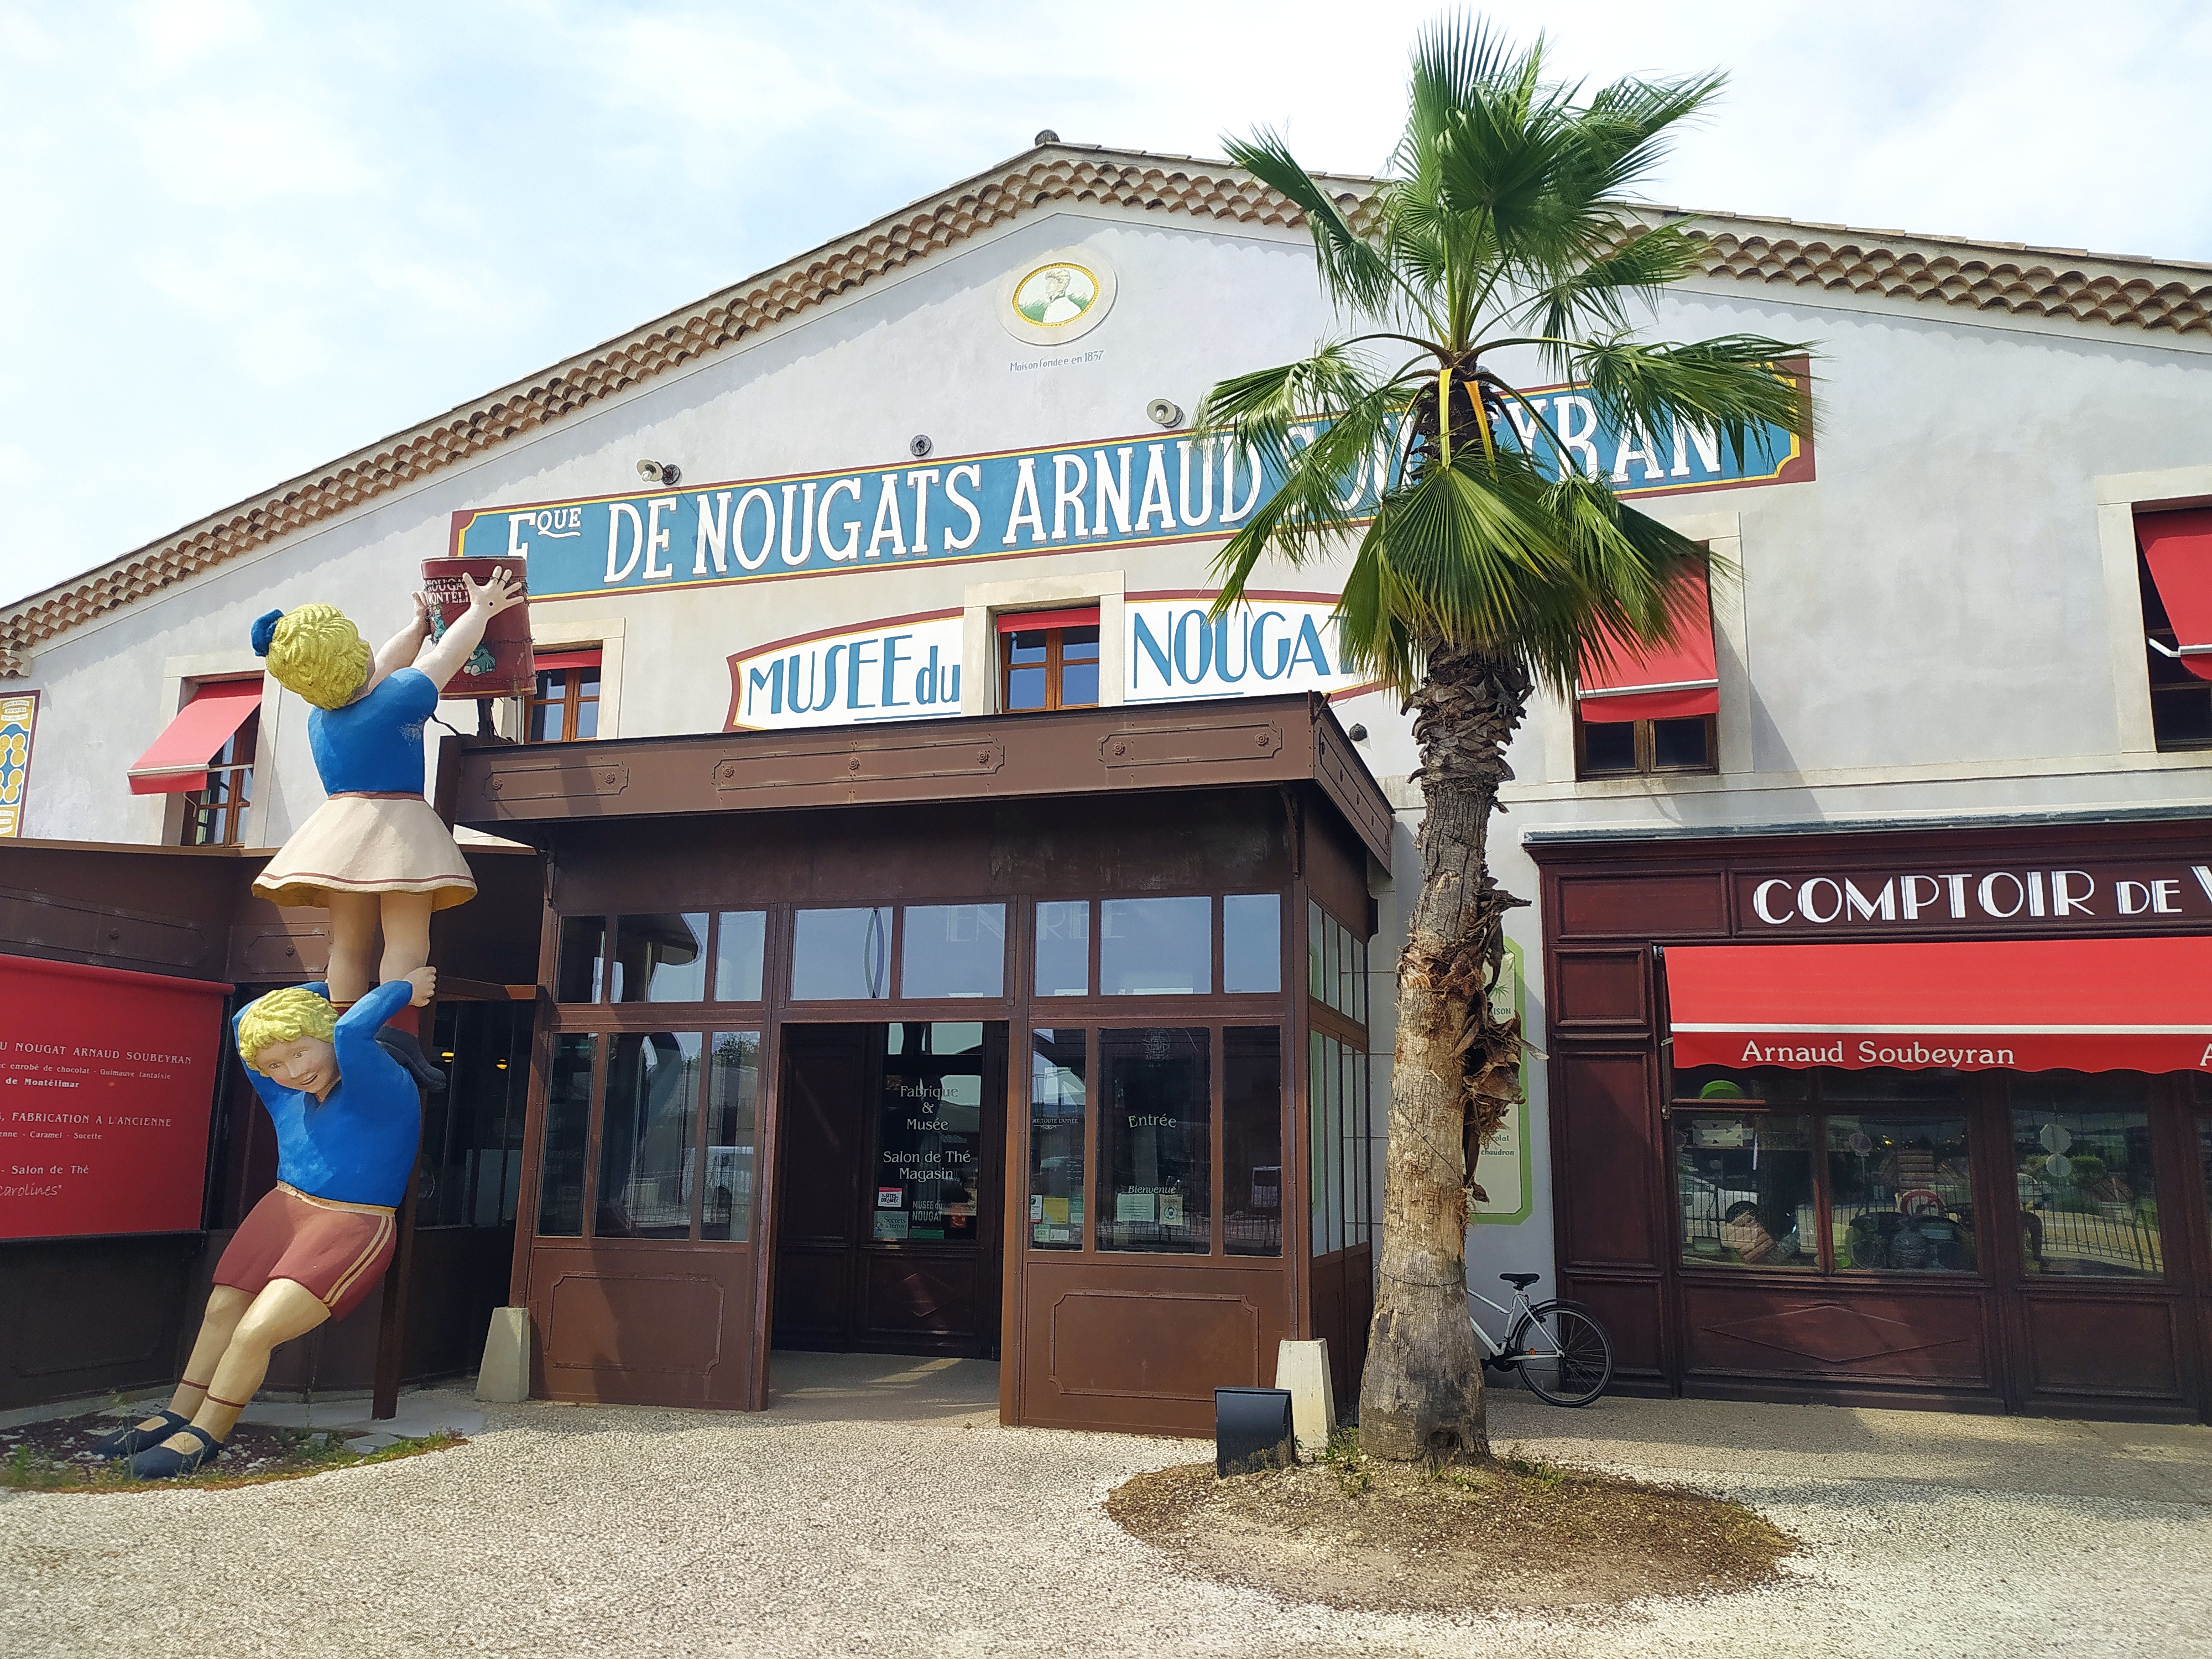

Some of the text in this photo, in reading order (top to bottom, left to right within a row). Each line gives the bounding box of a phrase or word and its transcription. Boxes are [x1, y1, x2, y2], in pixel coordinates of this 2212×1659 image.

[1009, 350, 1104, 372] Maison fondée en 1837
[604, 497, 677, 585] DE
[693, 463, 982, 576] NOUGATS
[1003, 440, 1262, 545] ARNAUD
[425, 578, 468, 592] NOUGA
[747, 634, 914, 716] MUSEE
[916, 645, 961, 705] du
[1752, 870, 2095, 925] COMPTOIR
[2116, 879, 2183, 915] DE
[15, 1042, 66, 1055] NOUGAT
[72, 1047, 120, 1059] ARNAUD
[126, 1051, 192, 1065] SOUBEYRAN
[1741, 1039, 2015, 1068] Arnaud Soubeyran
[56, 1066, 90, 1074] chocolat
[100, 1068, 135, 1077] Guimauve
[139, 1071, 171, 1079] fantaisie
[24, 1078, 80, 1088] Montélimar
[900, 1086, 959, 1100] Fabrique
[922, 1102, 935, 1114] &
[12, 1112, 90, 1124] FABRICATION
[95, 1115, 103, 1124] A
[108, 1116, 172, 1128] L'ANCIENNE
[906, 1118, 949, 1131] Musée
[1128, 1113, 1177, 1128] Entrée
[883, 1150, 971, 1164] Salon de Thé
[11, 1165, 44, 1175] Salon
[49, 1165, 63, 1174] de
[70, 1165, 90, 1174] Thé
[899, 1167, 954, 1183] Magasin
[1128, 1185, 1176, 1194] Bienvenue
[935, 1199, 943, 1209] du
[912, 1210, 943, 1222] NOUGAT
